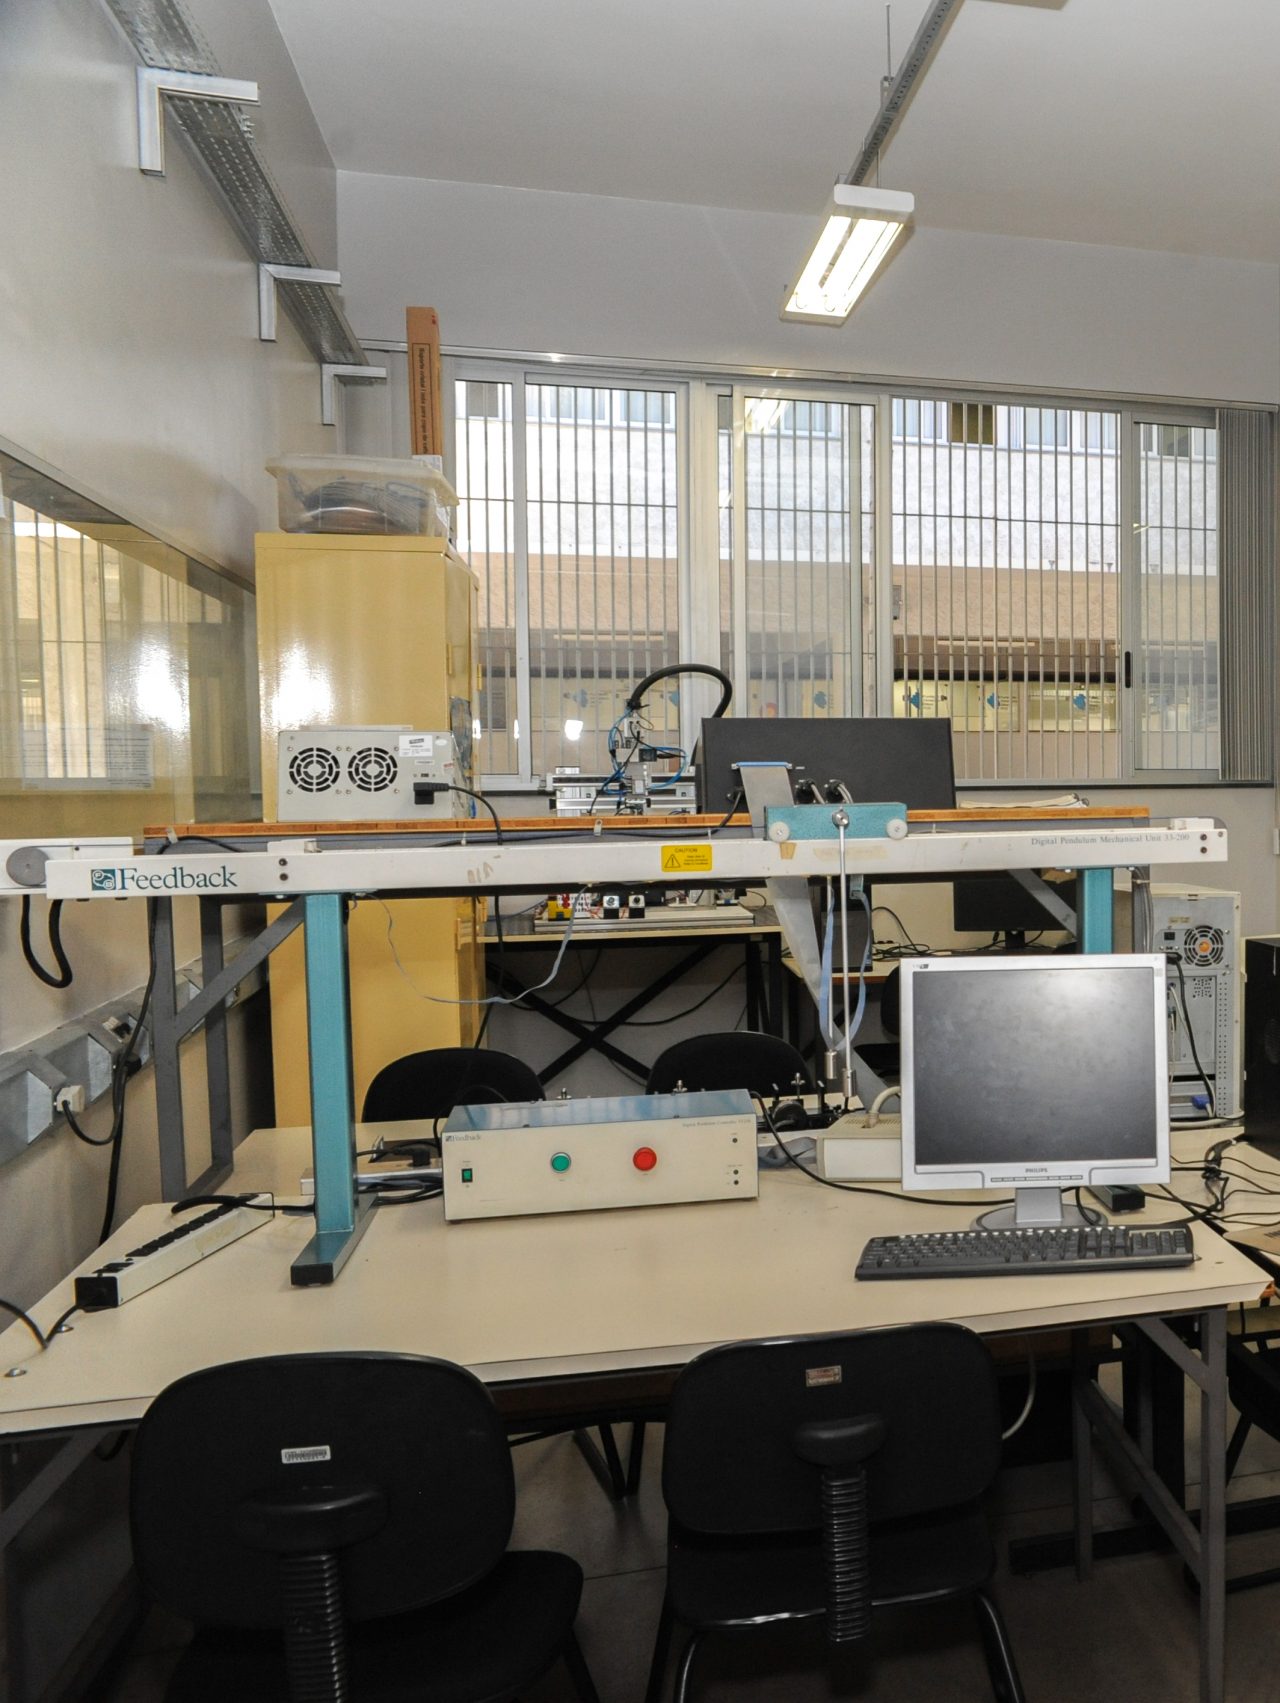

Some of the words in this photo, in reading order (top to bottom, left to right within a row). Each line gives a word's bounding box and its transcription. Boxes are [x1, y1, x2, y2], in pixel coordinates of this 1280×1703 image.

[1031, 837, 1057, 846] Digital
[1060, 836, 1097, 845] Pendulum
[1100, 835, 1142, 843] Mechanical
[1145, 834, 1161, 842] Unit
[117, 865, 238, 891] Feedback
